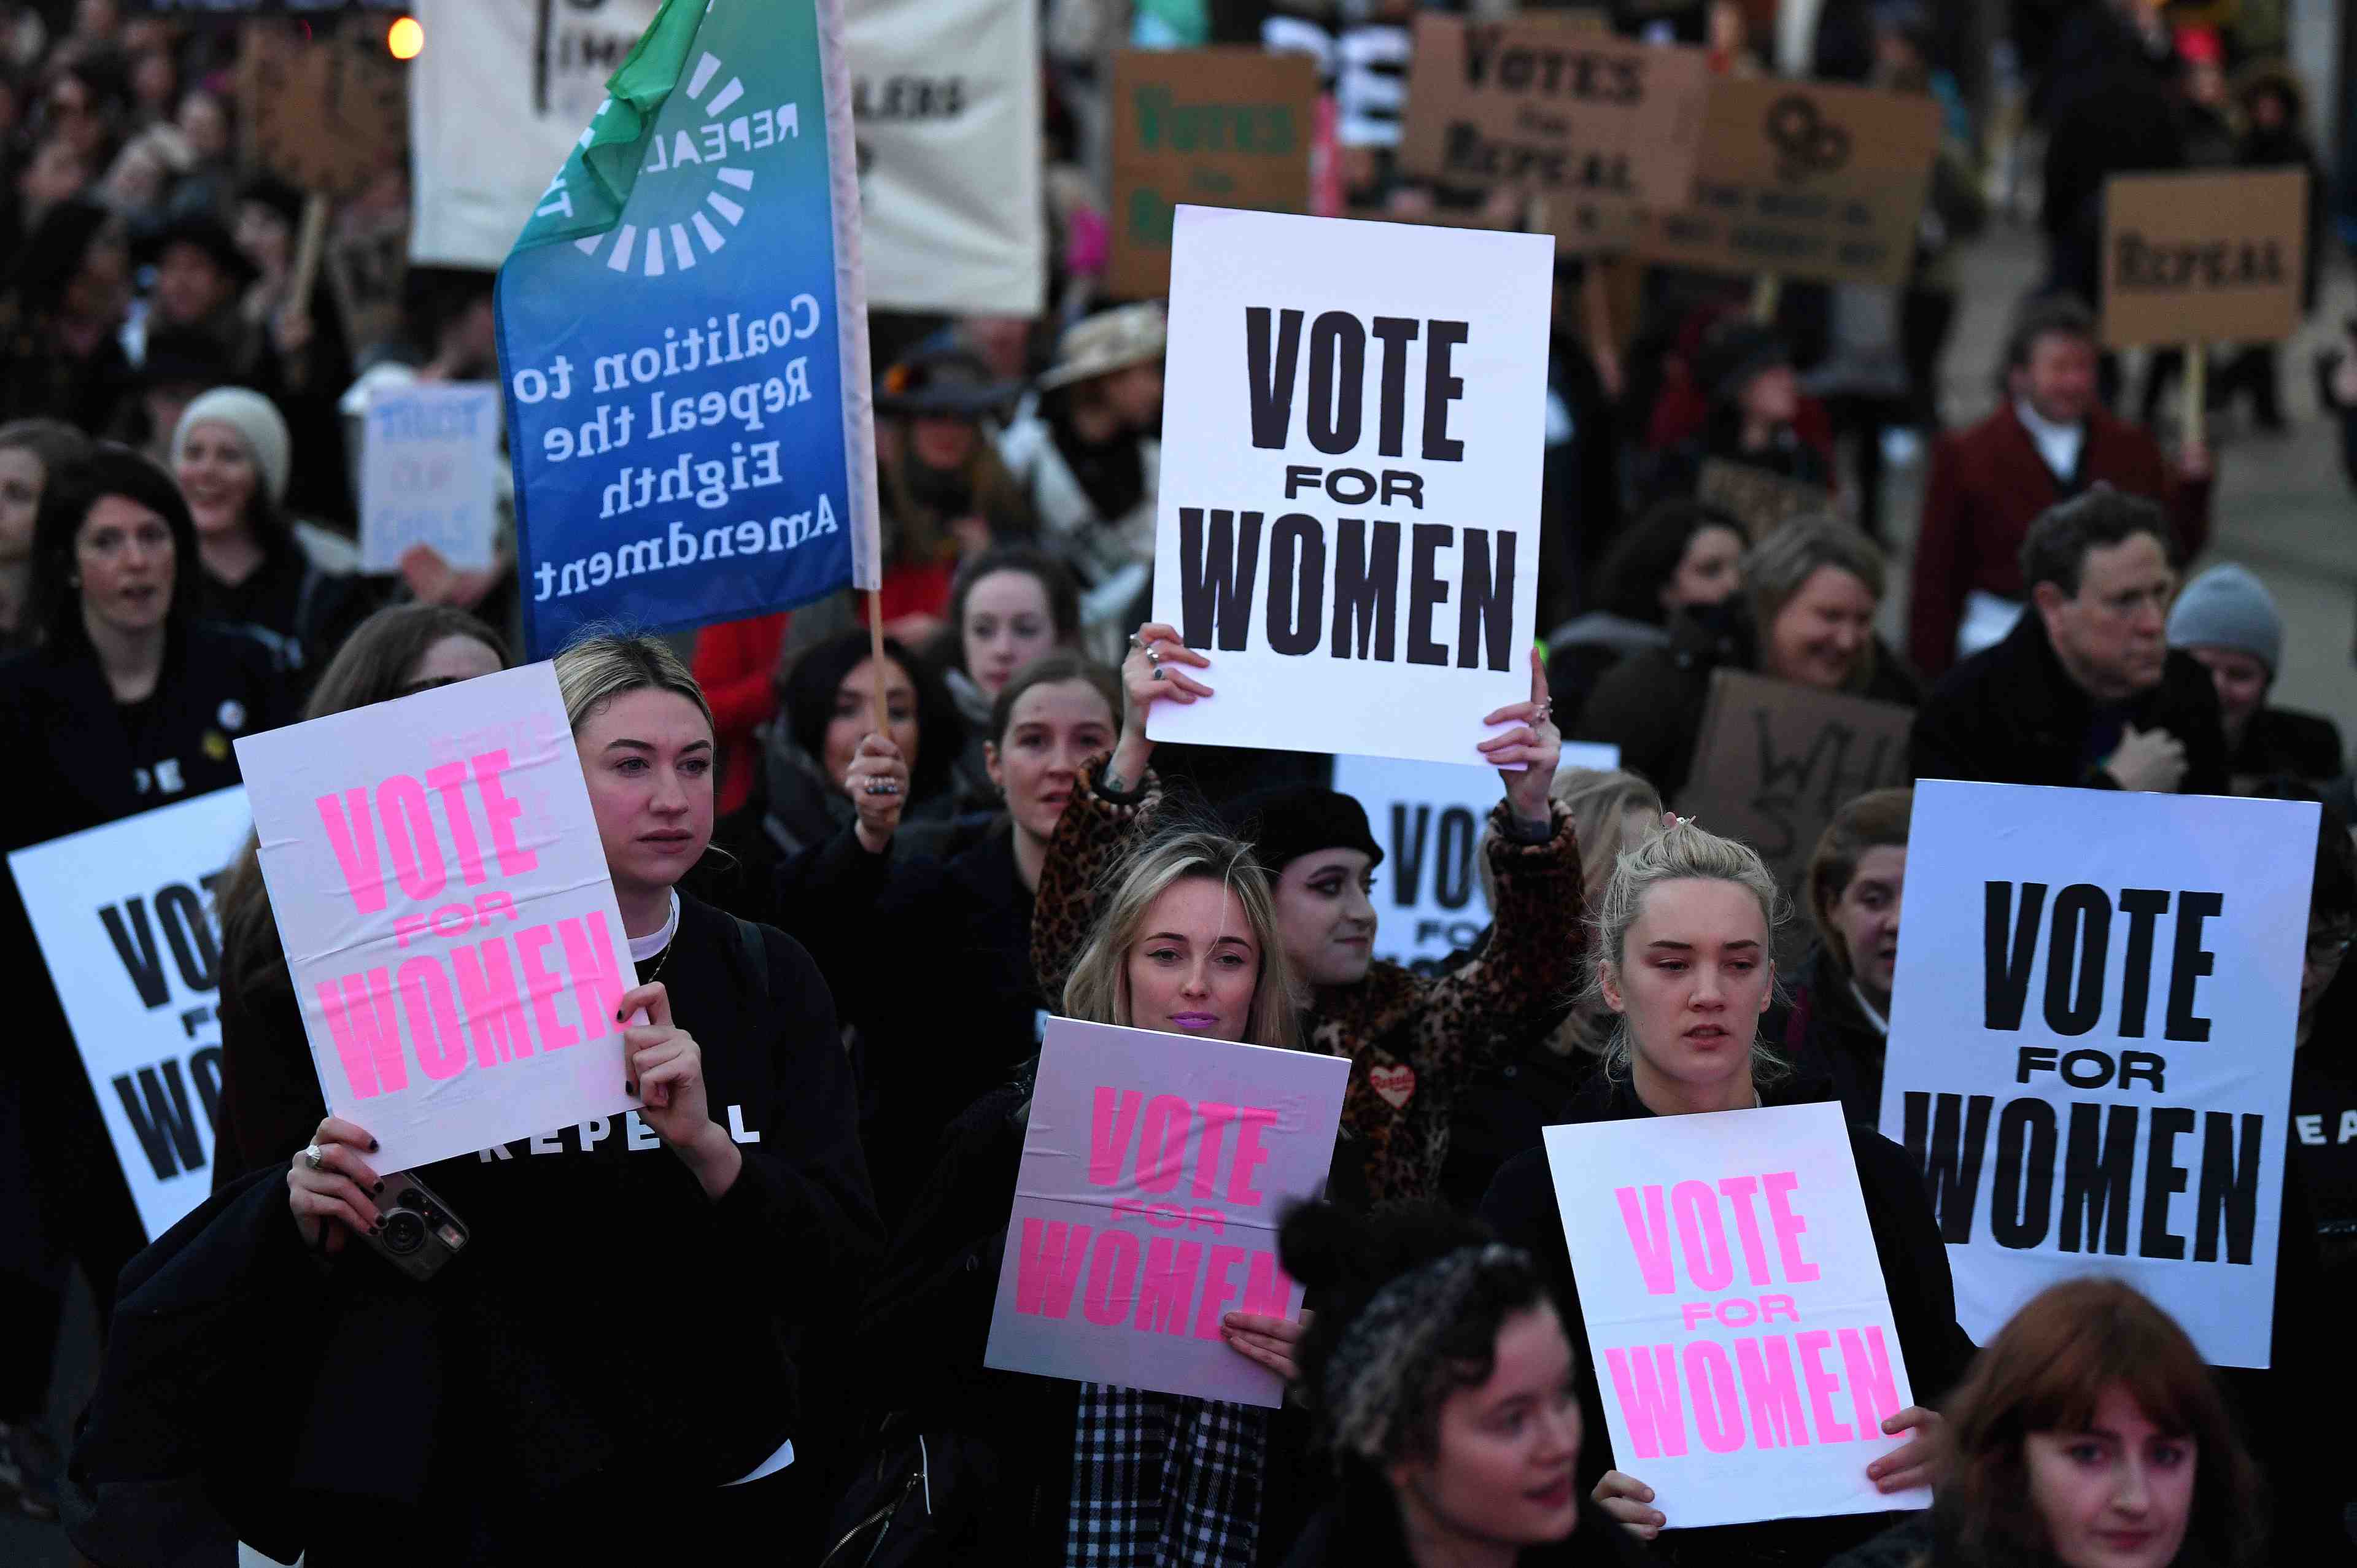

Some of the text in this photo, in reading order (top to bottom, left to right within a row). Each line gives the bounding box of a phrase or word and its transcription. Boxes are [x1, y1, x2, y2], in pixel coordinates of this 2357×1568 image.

[1246, 306, 1469, 462] VOTE
[1285, 465, 1425, 509] FOR
[1178, 508, 1517, 672] WOMEN
[315, 748, 539, 915] VOTE
[1391, 803, 1493, 910] VO
[98, 871, 227, 1011] VO
[393, 890, 518, 948] FOR
[1415, 919, 1480, 948] FO
[1984, 880, 2224, 1043] VOTE
[314, 910, 632, 1100] WOMEN
[2016, 1046, 2166, 1093] FOR
[1089, 1086, 1278, 1207] VOTE
[1903, 1091, 2264, 1265] WOMEN
[1110, 1197, 1226, 1236] FOR
[1614, 1172, 1821, 1295] VOTE
[1681, 1294, 1800, 1330] FOR
[1603, 1326, 1905, 1459] WOMEN
